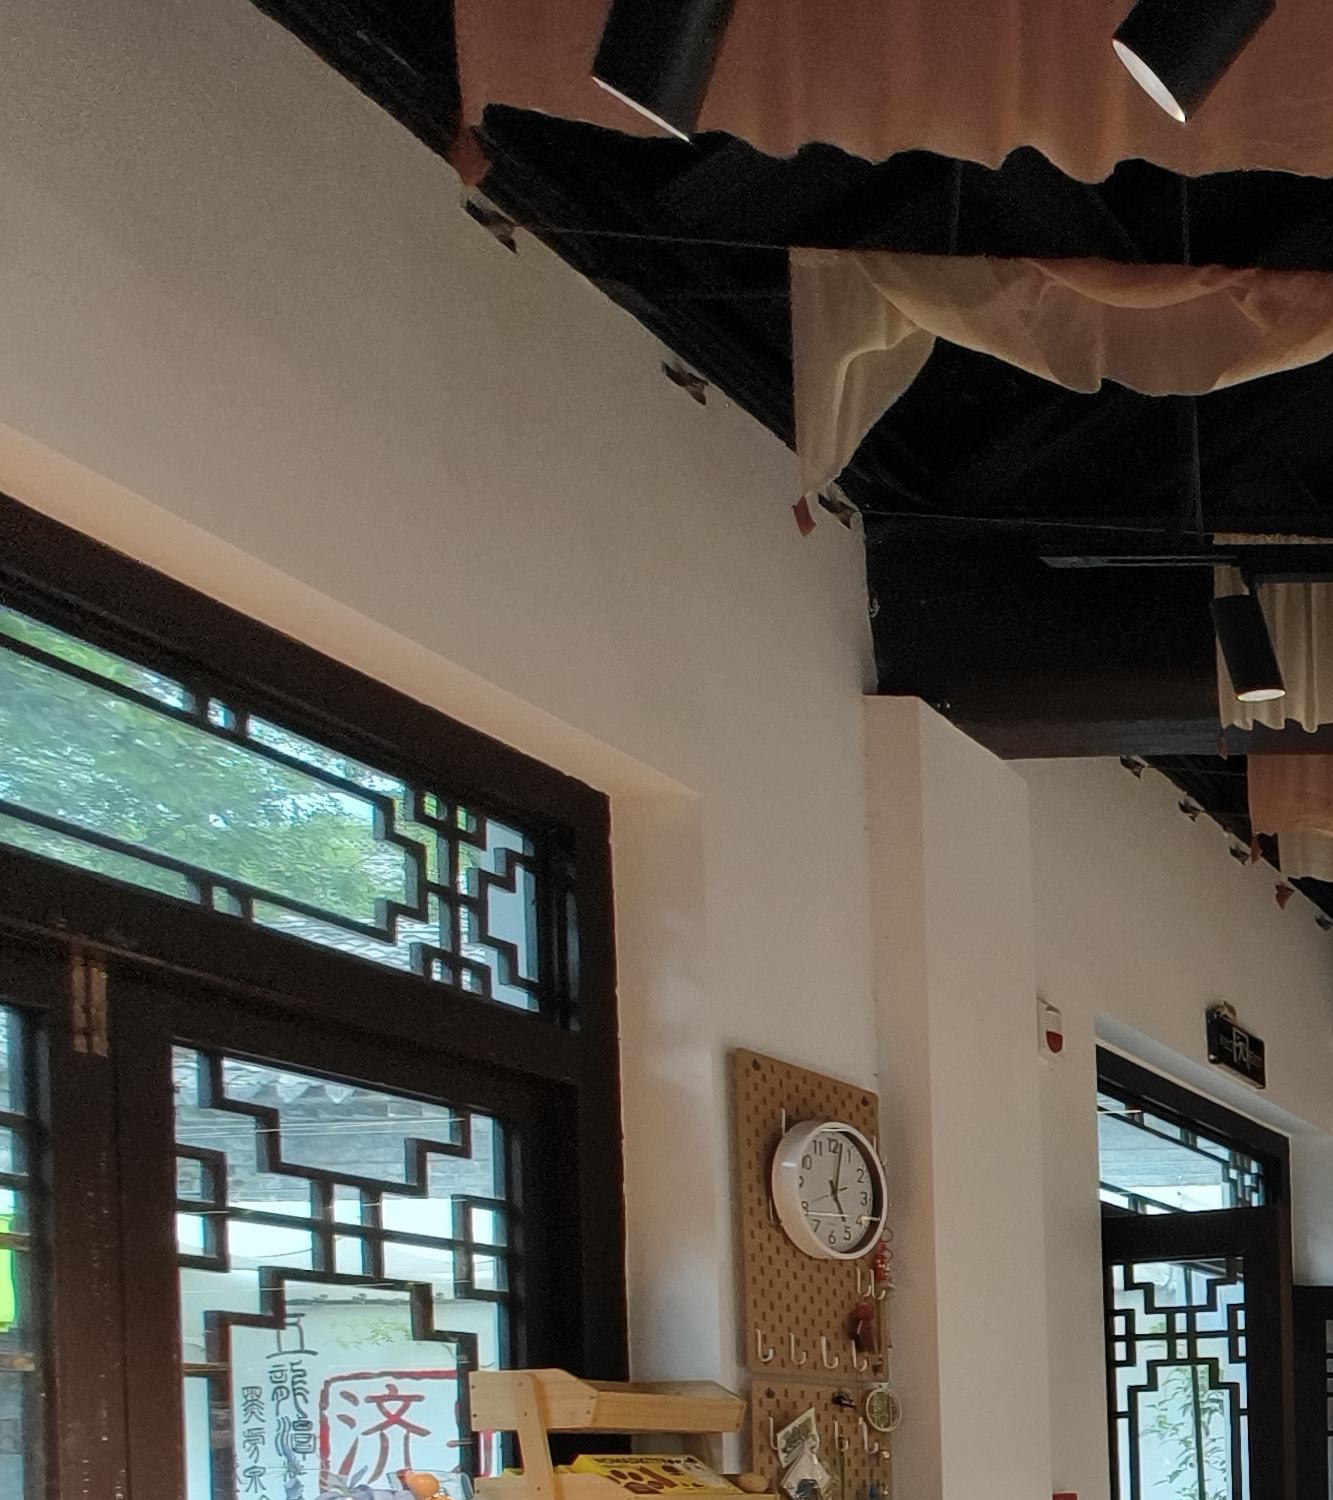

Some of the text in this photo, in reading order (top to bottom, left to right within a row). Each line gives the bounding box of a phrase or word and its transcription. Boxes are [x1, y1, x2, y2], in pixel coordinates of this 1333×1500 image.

[812, 1139, 823, 1156] 11
[827, 1138, 839, 1154] 12
[802, 1155, 812, 1170] 10
[847, 1148, 852, 1164] 1
[856, 1168, 865, 1183] 2
[860, 1191, 868, 1206] 3
[812, 1219, 820, 1233] 7
[843, 1226, 851, 1241] 5
[828, 1230, 836, 1244] 6
[337, 1383, 432, 1485] 济
